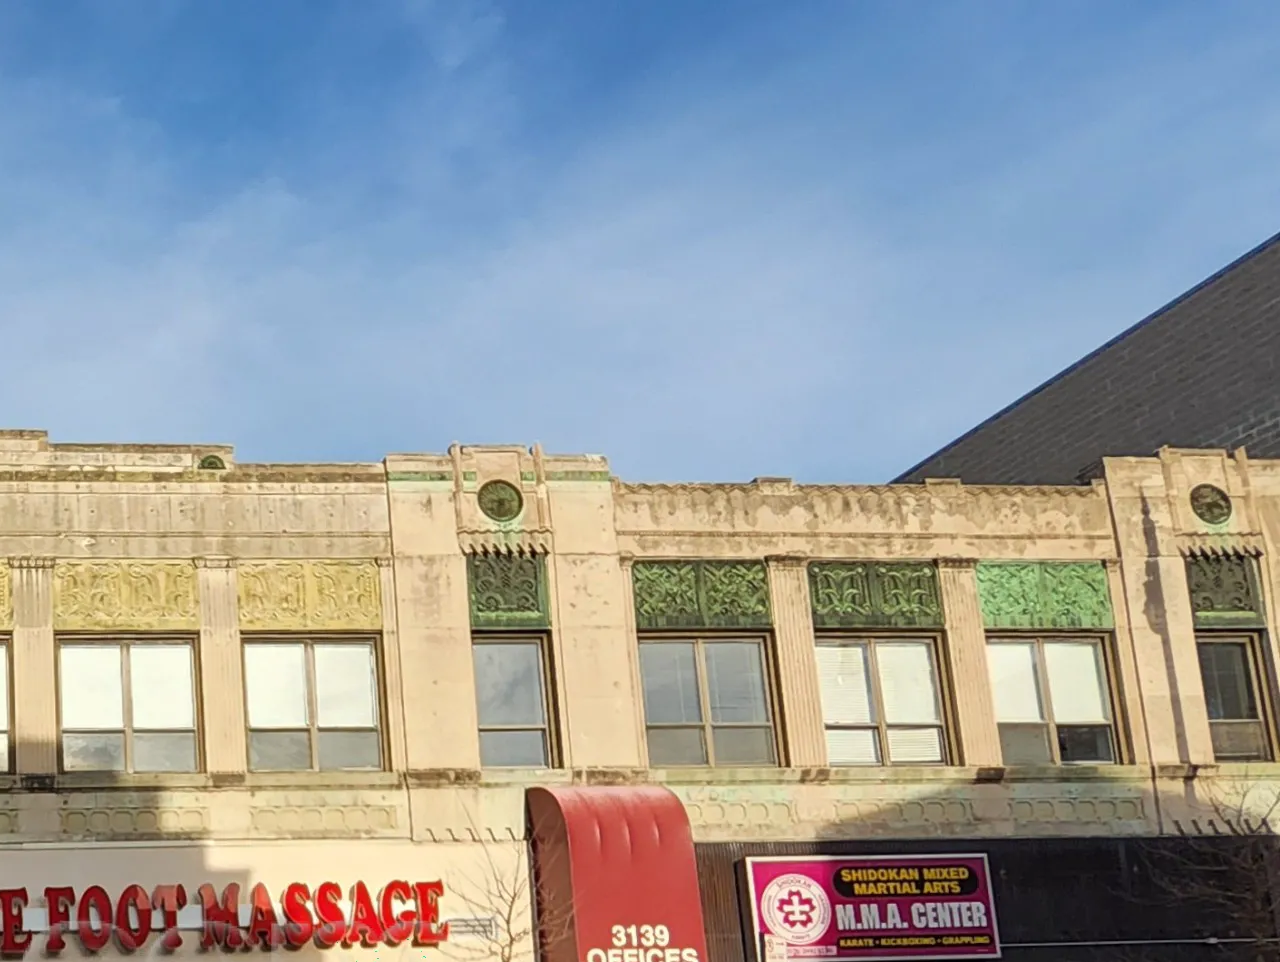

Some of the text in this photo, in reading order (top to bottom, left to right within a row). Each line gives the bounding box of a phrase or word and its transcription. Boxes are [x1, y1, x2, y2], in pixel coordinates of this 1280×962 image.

[841, 867, 969, 881] SHIDOKAN MIXED
[853, 882, 961, 895] MARTIAL ARTS
[44, 883, 186, 953] FOOT
[197, 878, 449, 949] MASSAGE
[836, 903, 909, 931] M.M.A.
[911, 901, 988, 928] CENTER
[611, 924, 670, 947] 3139
[839, 938, 874, 947] KARATE
[942, 936, 990, 945] GRAPPLING
